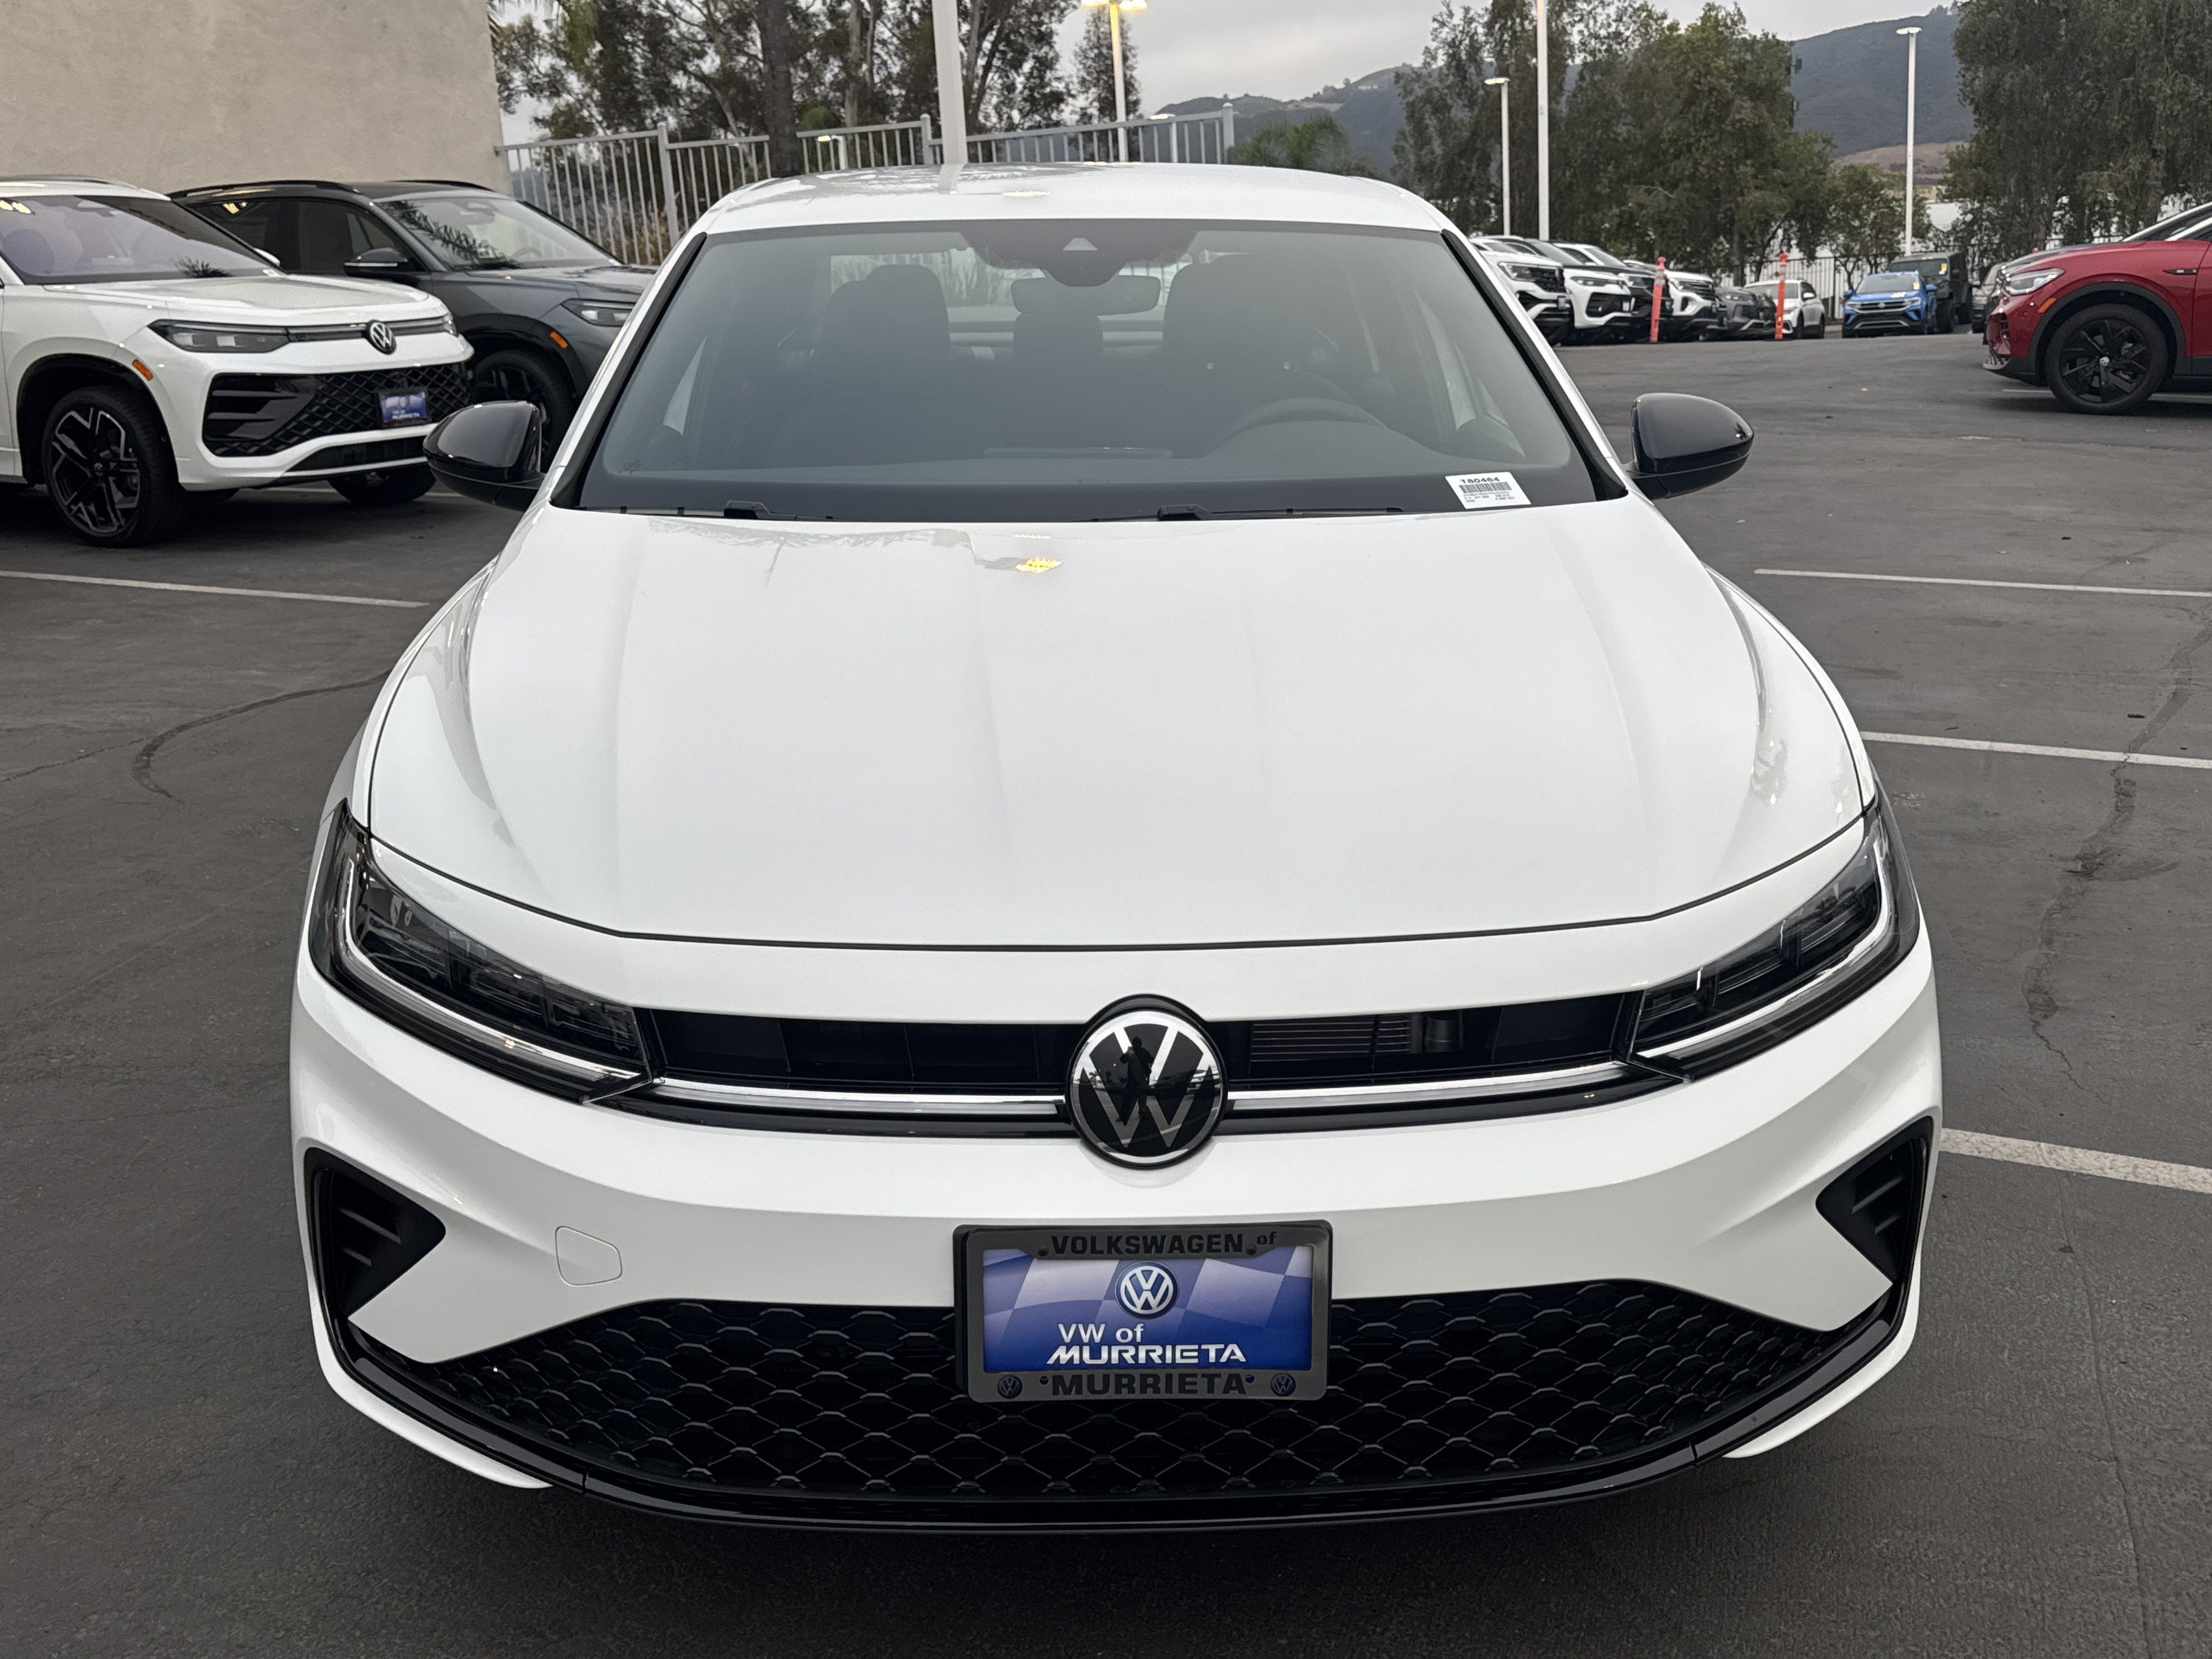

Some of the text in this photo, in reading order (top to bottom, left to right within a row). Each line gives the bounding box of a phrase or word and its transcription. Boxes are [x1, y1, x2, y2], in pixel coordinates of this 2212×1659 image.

[1071, 1011, 1223, 1164] VW
[1051, 1231, 1277, 1255] VOLKSWAGEN of
[1120, 1265, 1174, 1315] VW
[1058, 1323, 1144, 1343] VW of
[1046, 1344, 1247, 1364] MURRIETA
[1052, 1373, 1246, 1396] MURRIETA
